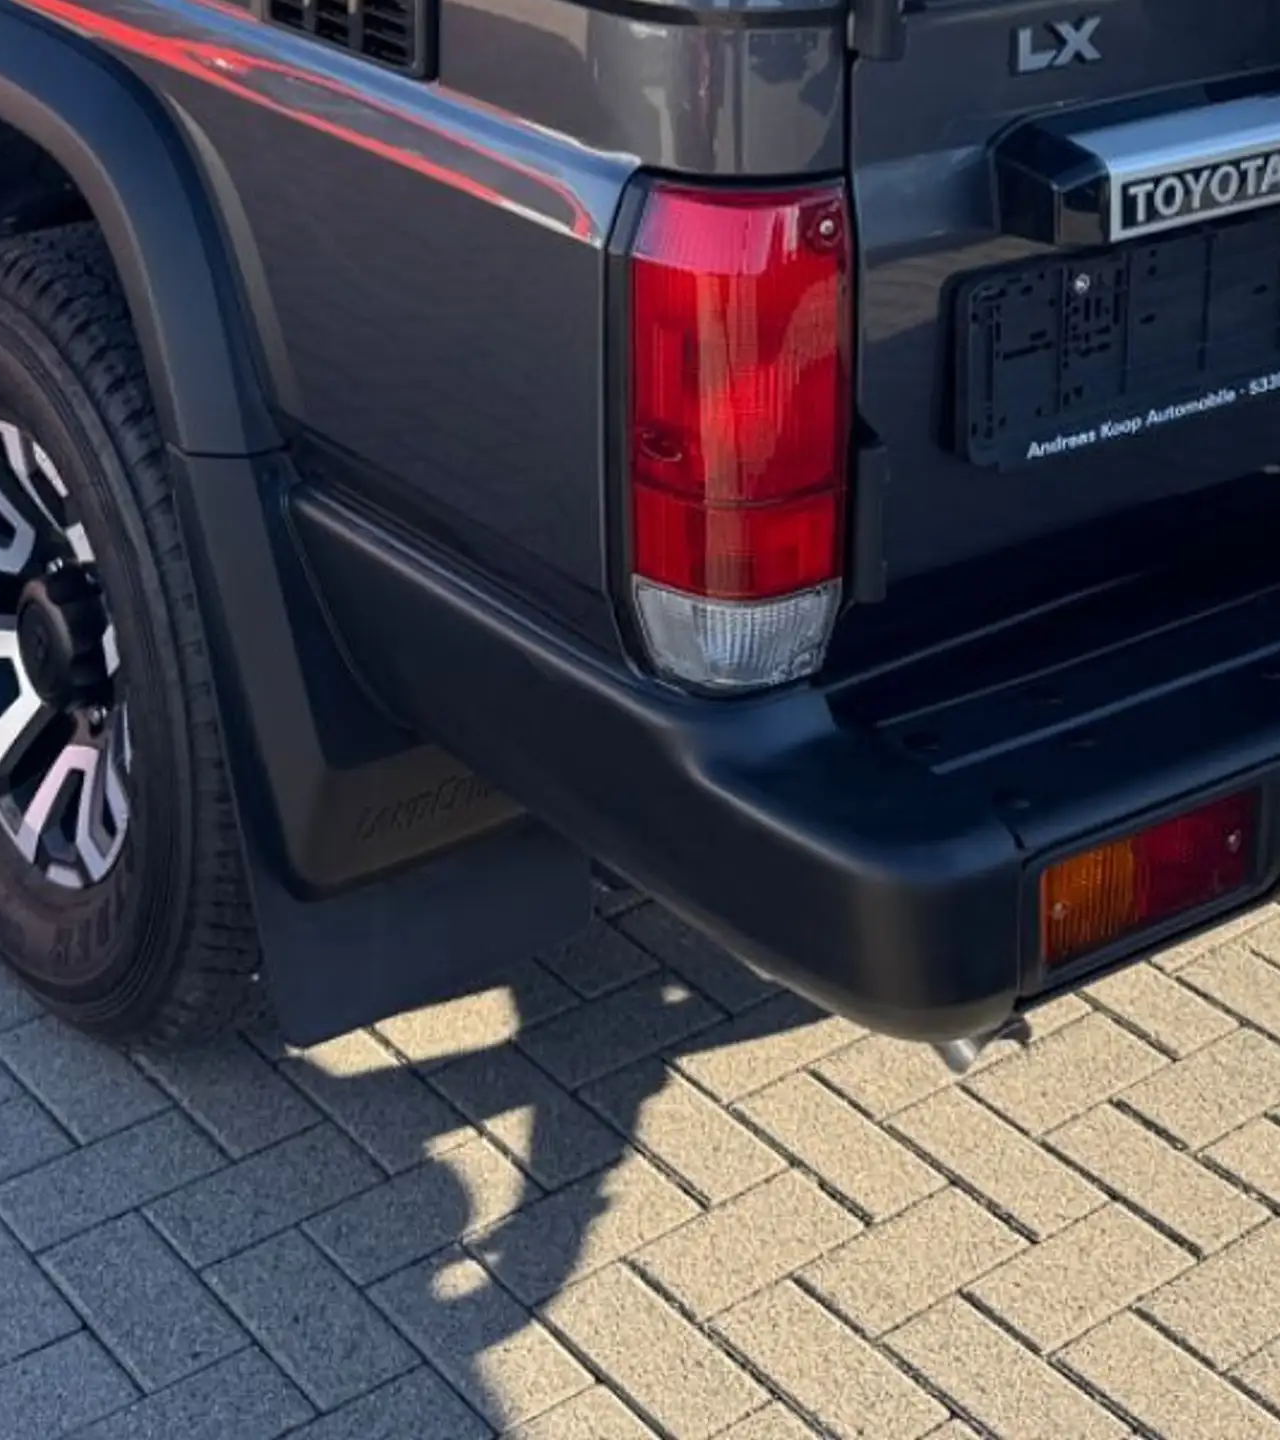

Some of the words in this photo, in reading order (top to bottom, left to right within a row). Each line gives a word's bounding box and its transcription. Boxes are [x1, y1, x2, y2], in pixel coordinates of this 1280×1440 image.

[1018, 16, 1102, 73] LX
[1026, 427, 1096, 459] Andreas
[1100, 417, 1143, 440] Koop
[1146, 388, 1237, 426] Automobile
